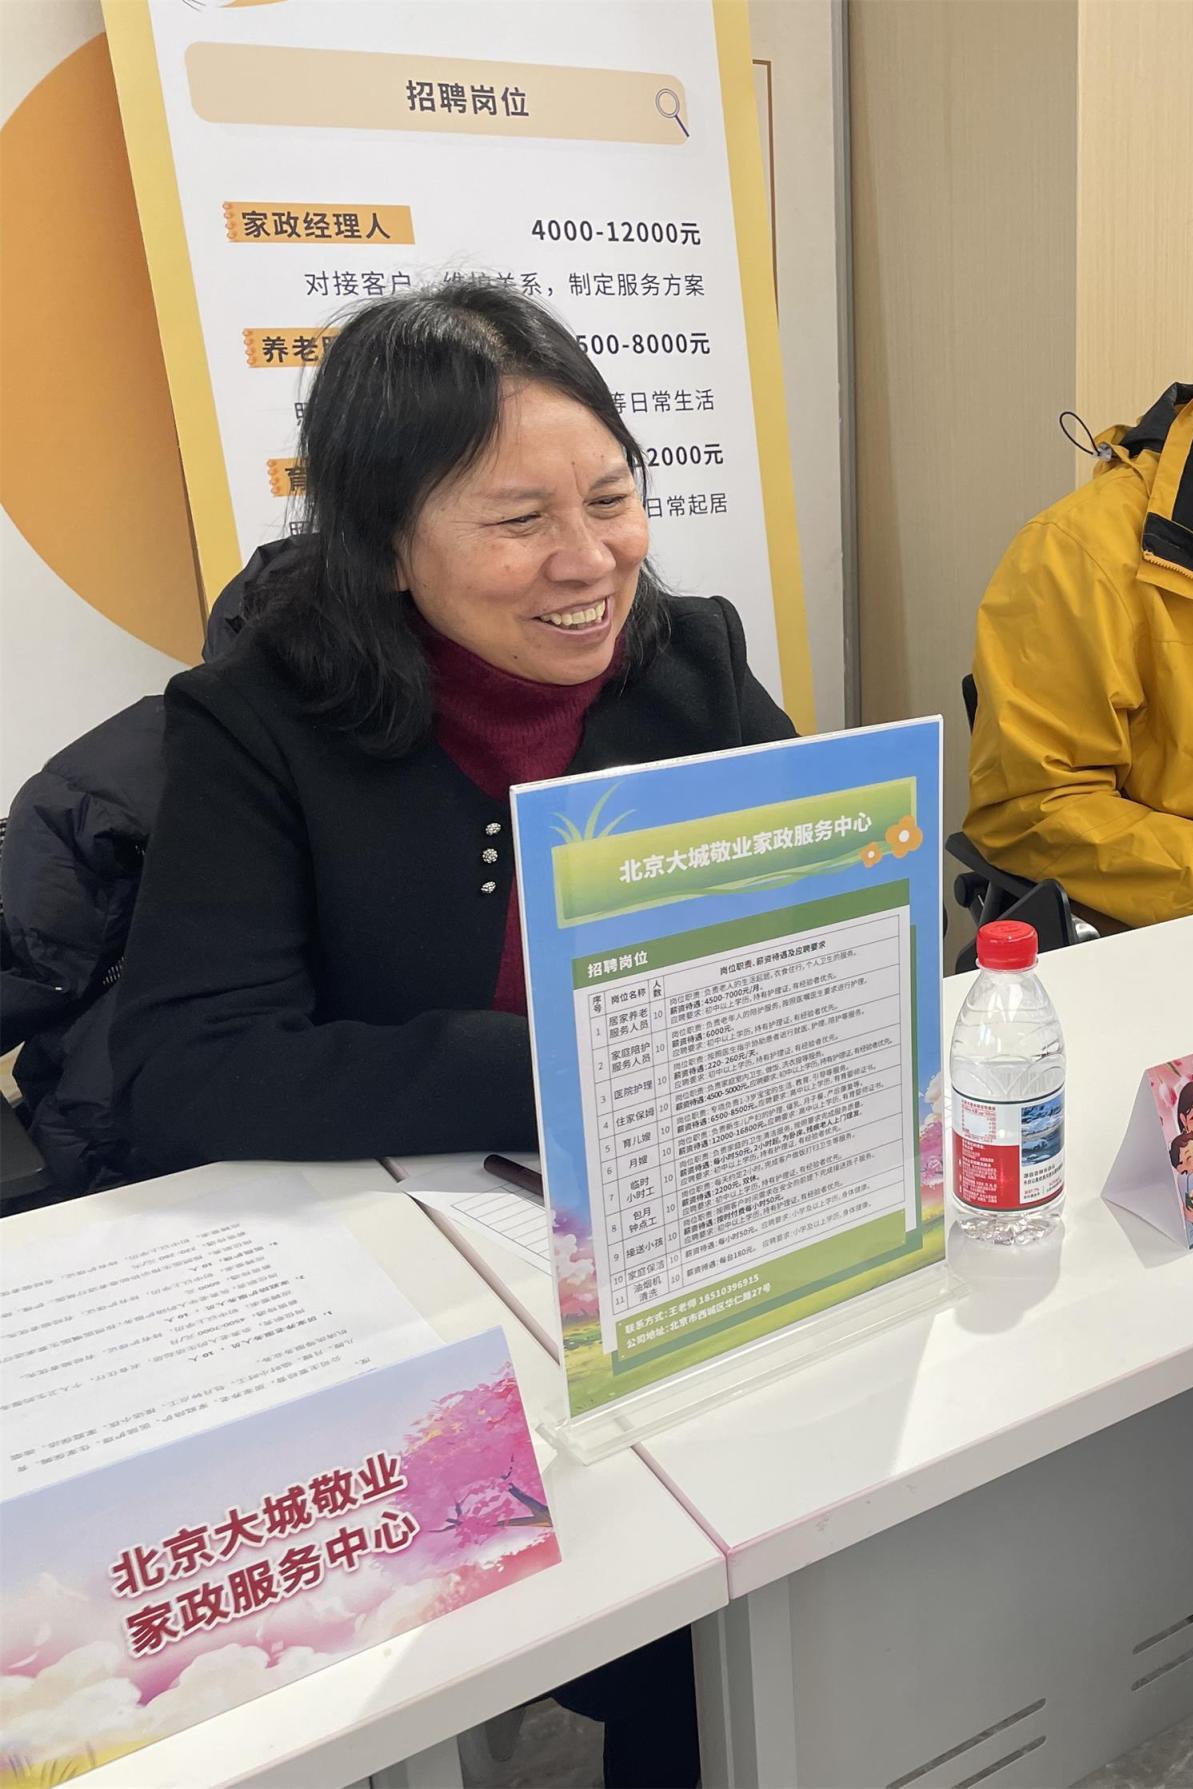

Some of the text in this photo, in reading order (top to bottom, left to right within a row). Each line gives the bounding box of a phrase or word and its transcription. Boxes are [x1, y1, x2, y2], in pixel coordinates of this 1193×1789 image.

[406, 80, 530, 118] 招聘岗位
[242, 210, 702, 246] 家政经理人 4000-12000元
[262, 335, 339, 363] 养老
[611, 388, 715, 414] 等日常生活
[635, 443, 724, 468] 2000元
[646, 491, 728, 518] 日常起居
[619, 812, 872, 884] 北京大城敬业家政服务中心
[588, 950, 649, 979] 招聘岗位
[610, 987, 646, 1005] 岗位名称
[608, 1006, 648, 1027] 居家养老
[608, 1018, 649, 1039] 服务人员
[610, 1040, 650, 1062] 家庭陪护
[611, 1052, 651, 1073] 服务人员
[613, 1079, 653, 1100] 医院护理
[615, 1106, 655, 1128] 住家保姆
[622, 1130, 651, 1150] 育儿嫂
[628, 1153, 648, 1169] 月嫂
[626, 1184, 654, 1204] 小时工
[629, 1175, 649, 1191] 临时
[632, 1205, 651, 1221] 包月
[628, 1215, 657, 1234] 钟点工
[625, 1236, 663, 1259] 接送小孩
[627, 1258, 664, 1281] 家庭保洁
[633, 1274, 661, 1294] 油烟机
[638, 1286, 658, 1303] 清洗
[111, 1452, 404, 1598] 北京大城敬业
[125, 1510, 416, 1655] 家政服务中心
